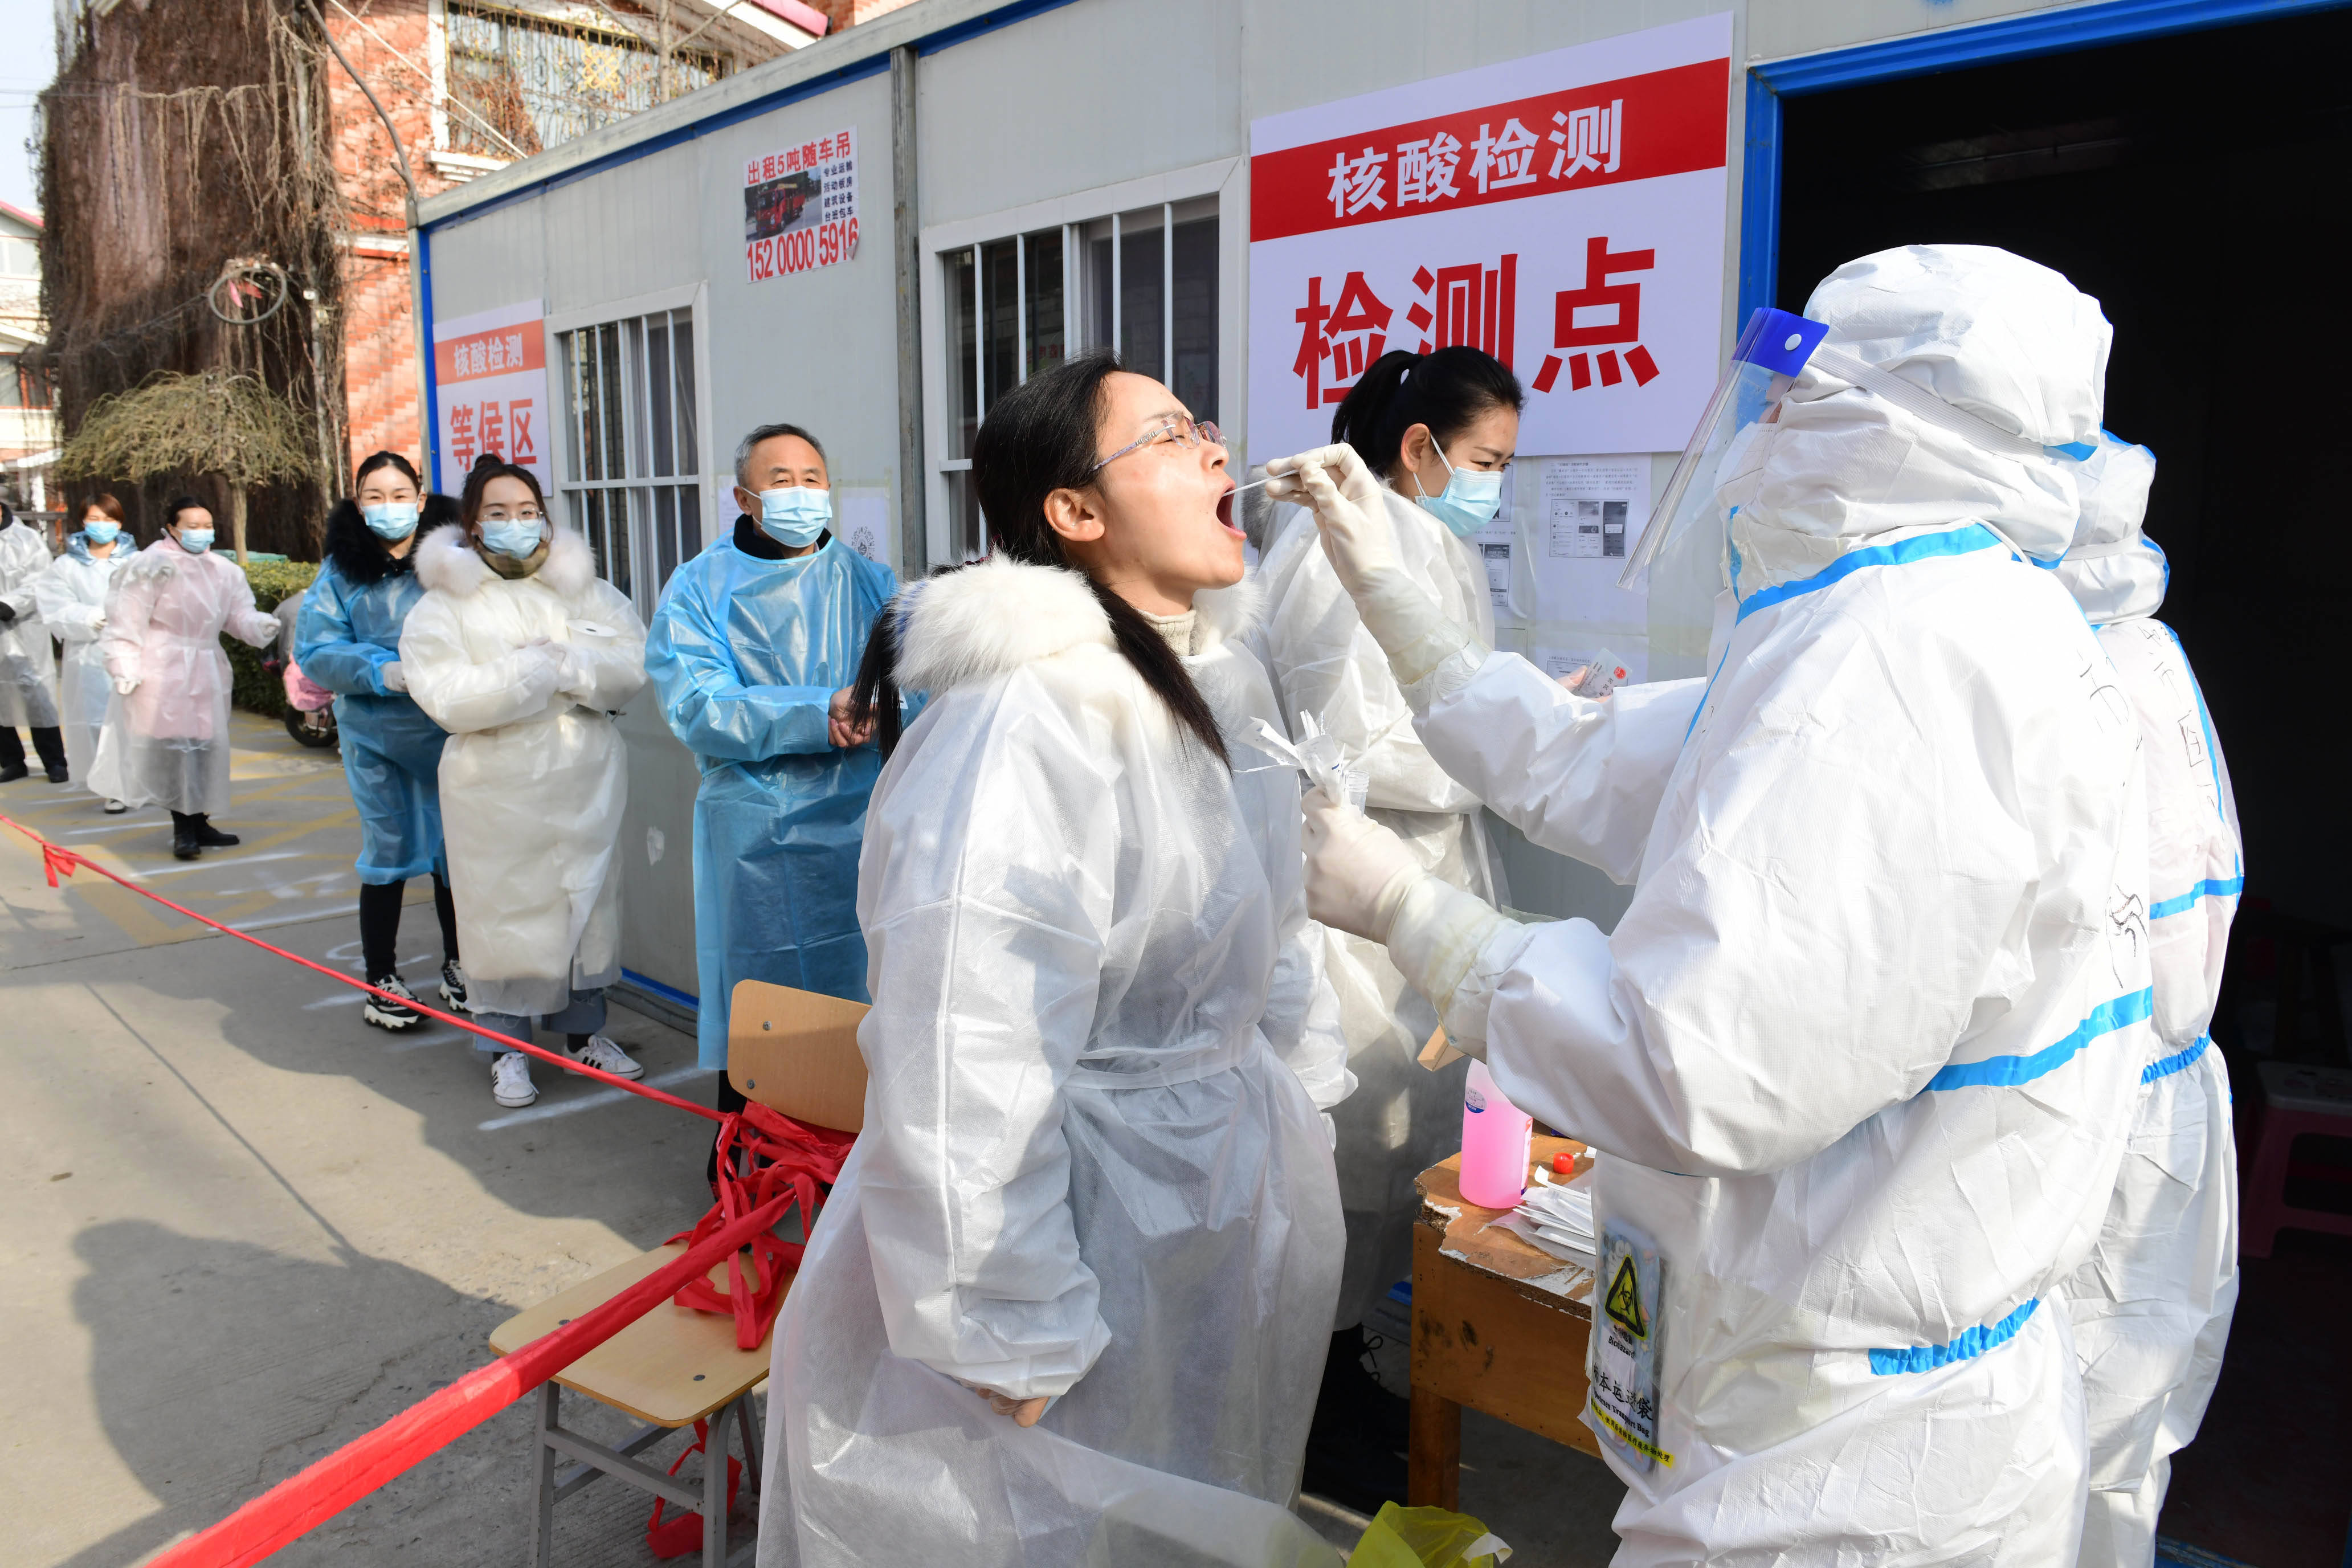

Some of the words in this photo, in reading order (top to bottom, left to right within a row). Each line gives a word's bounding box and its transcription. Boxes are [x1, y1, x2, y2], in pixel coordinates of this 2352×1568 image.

[748, 131, 851, 185] 出租5吨随车吊
[824, 160, 852, 177] 专业运输
[1328, 99, 1624, 218] 核酸检测
[748, 239, 773, 281] 152
[777, 228, 815, 275] 0000
[819, 217, 858, 266] 5916
[1293, 236, 1660, 410] 检测点
[454, 333, 523, 377] 核酸检测
[1636, 1423, 1649, 1438] Bag
